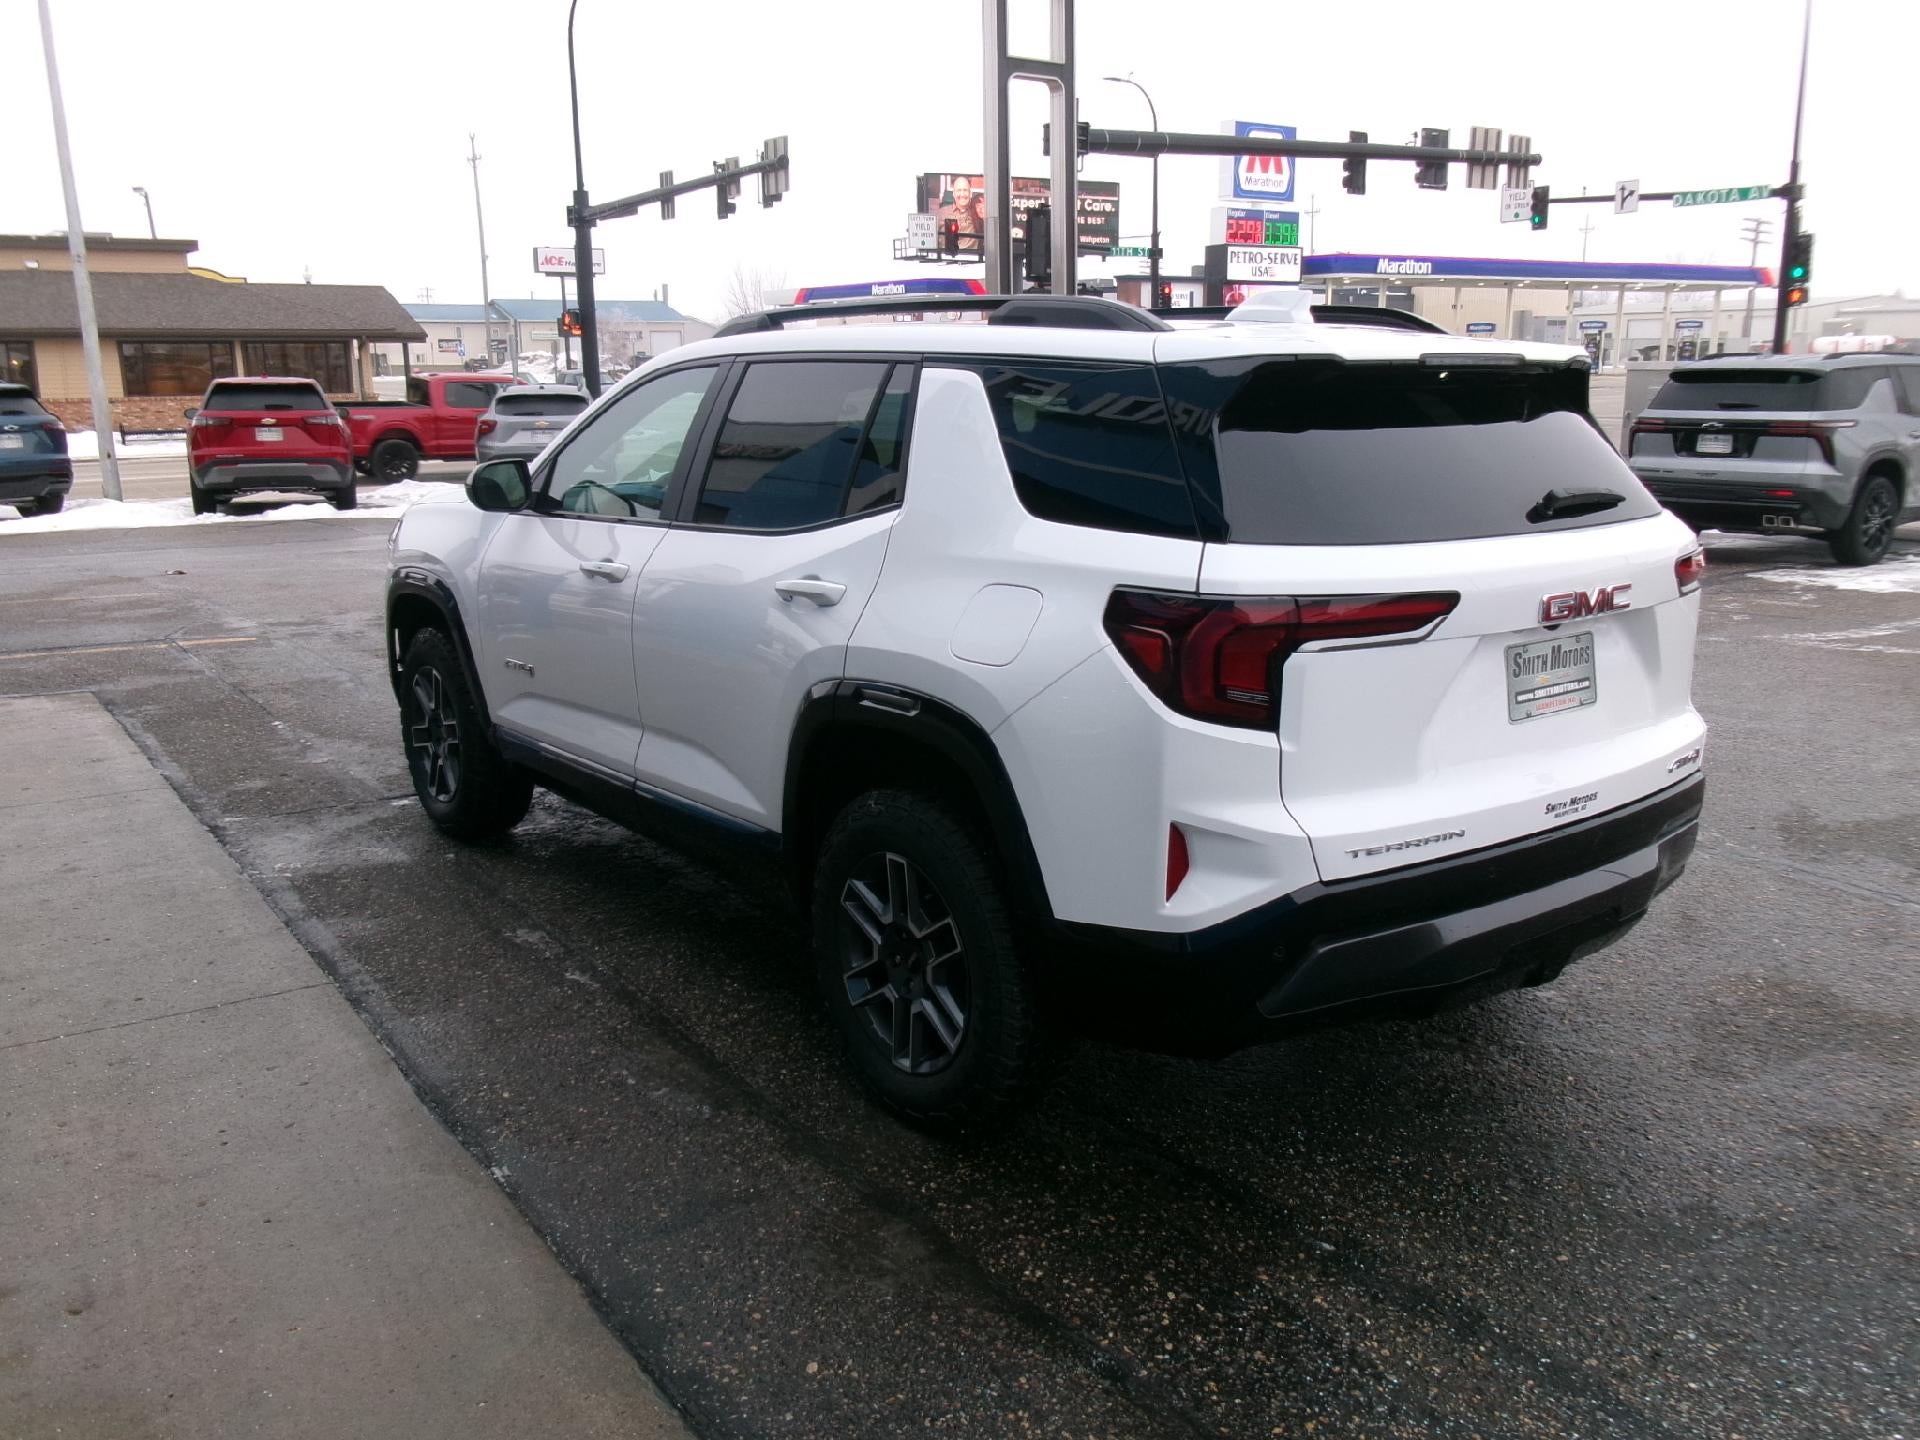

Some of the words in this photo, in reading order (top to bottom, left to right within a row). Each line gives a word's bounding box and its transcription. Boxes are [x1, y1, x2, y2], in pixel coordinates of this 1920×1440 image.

[1244, 175, 1284, 188] Marathon
[1673, 188, 1740, 207] DAKOTA
[1085, 199, 1115, 211] Care.
[1088, 216, 1105, 224] BEST
[915, 223, 931, 231] YIELD
[541, 254, 565, 266] ACE
[1230, 251, 1299, 265] PETRO-SERVE
[1252, 266, 1269, 277] USA
[1376, 258, 1432, 274] Marathon
[871, 284, 906, 296] Marathon
[1538, 583, 1632, 623] GMC
[1550, 644, 1590, 671] MOTORS
[1569, 792, 1598, 807] MOTORS
[1344, 829, 1466, 858] TERRAIN
